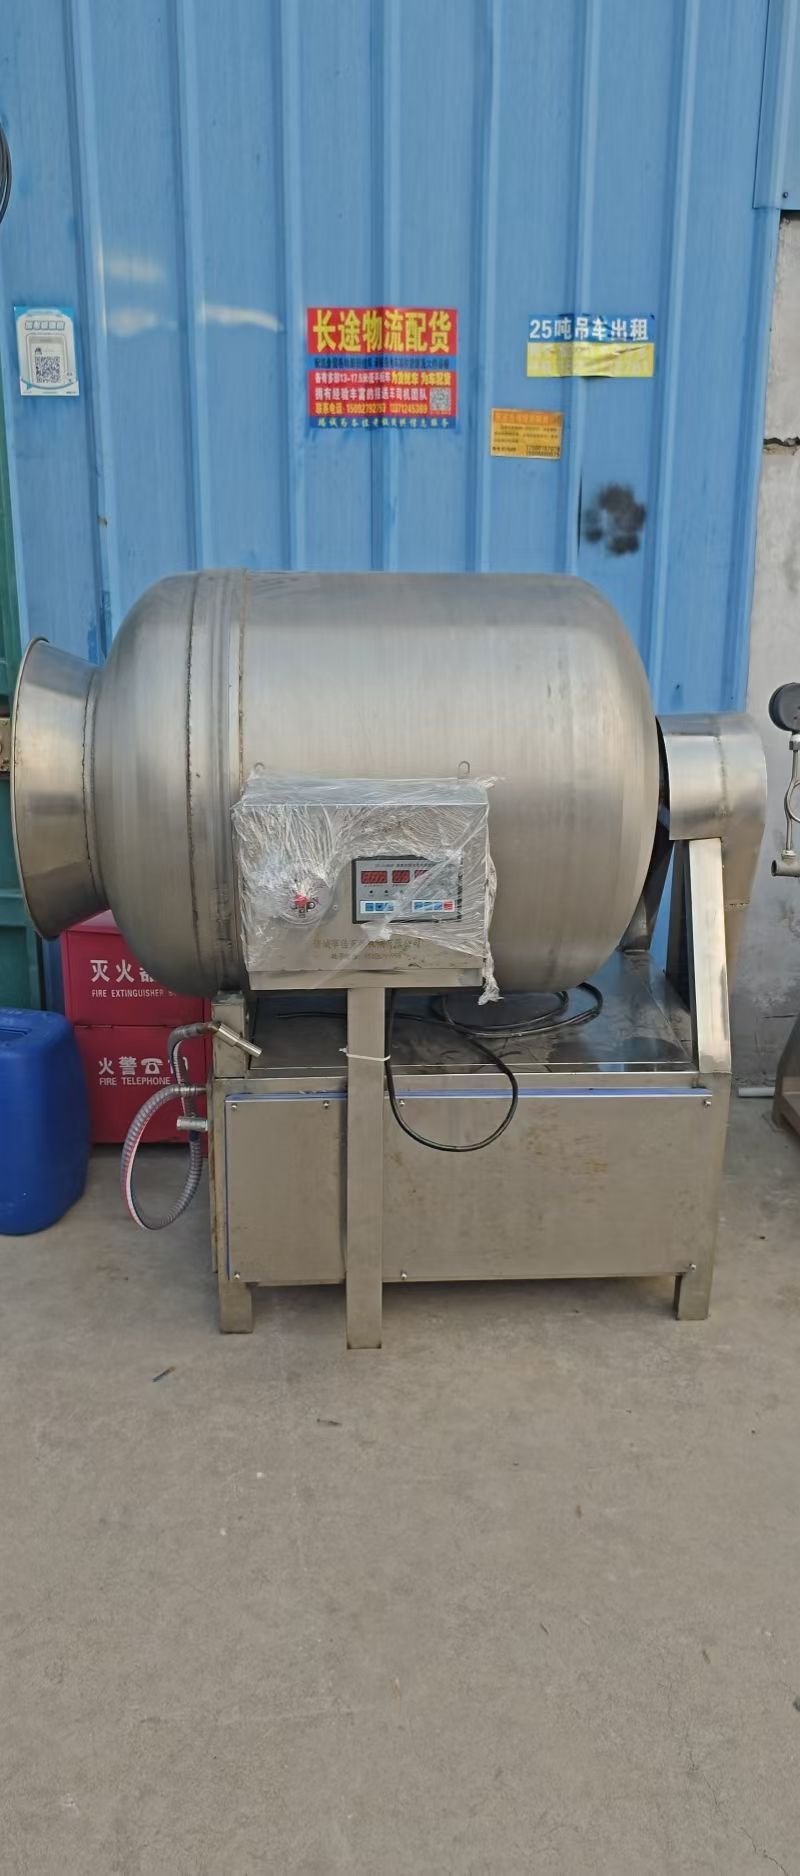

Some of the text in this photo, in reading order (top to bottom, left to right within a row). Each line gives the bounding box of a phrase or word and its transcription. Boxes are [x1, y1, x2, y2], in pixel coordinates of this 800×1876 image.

[312, 309, 451, 353] 长途物流配货
[529, 316, 649, 341] 25吨吊车出租
[91, 989, 107, 998] FIRE
[111, 989, 164, 998] EXTINGUISHER
[98, 1056, 138, 1076] 火警
[99, 1076, 171, 1086] FIRE TELEPHONE
